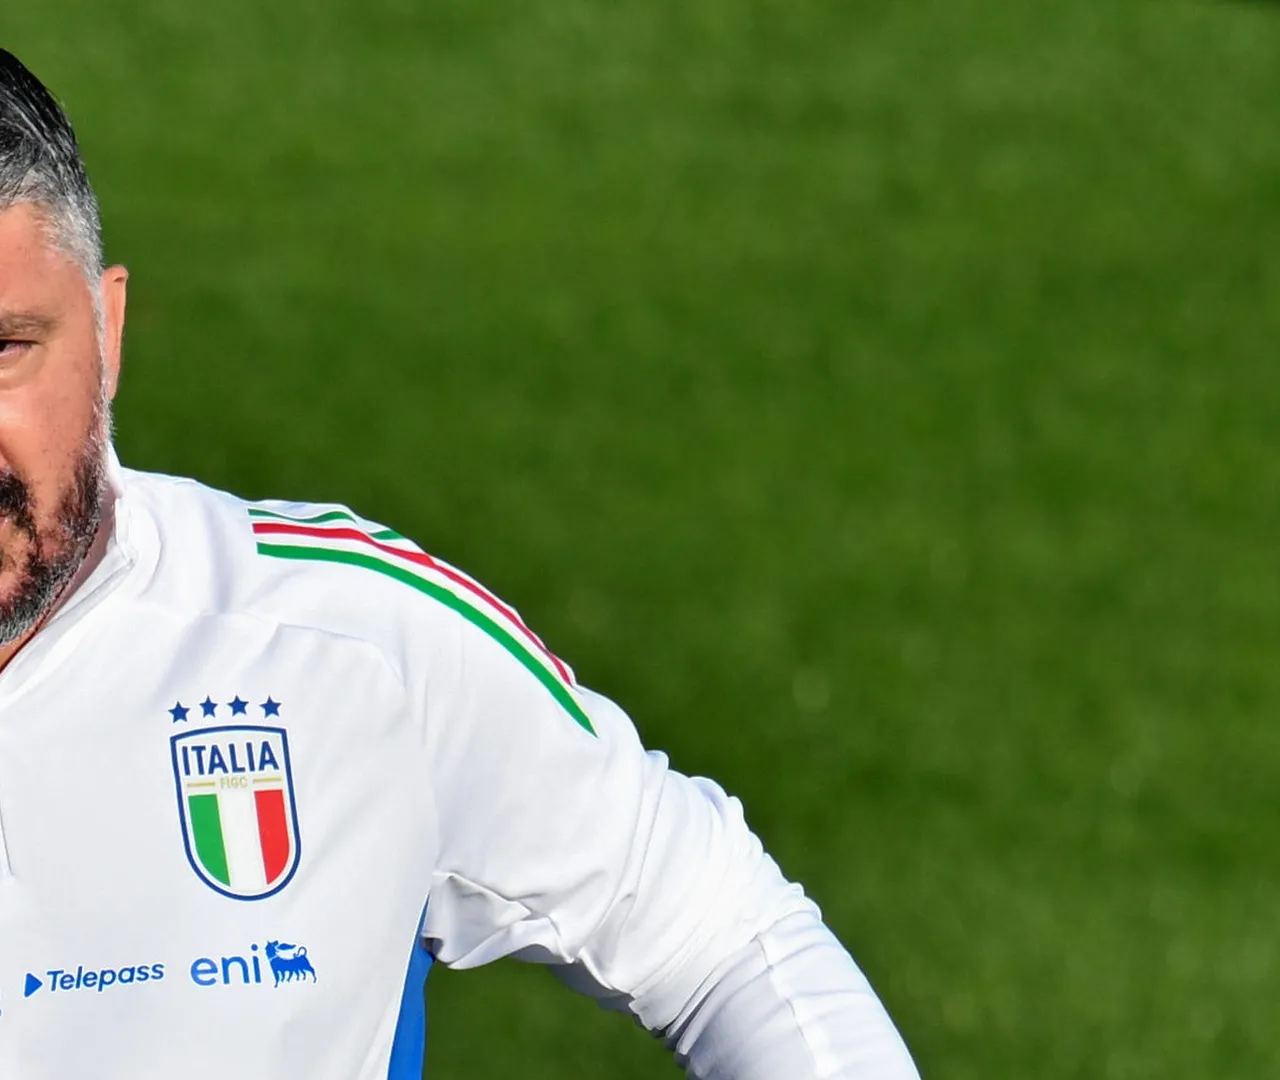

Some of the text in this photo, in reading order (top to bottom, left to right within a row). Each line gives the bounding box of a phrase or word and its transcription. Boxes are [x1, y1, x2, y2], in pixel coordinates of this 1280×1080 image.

[182, 741, 279, 775] ITALIA
[220, 775, 248, 788] FIGC
[47, 964, 164, 992] Telepass
[190, 944, 261, 986] eni
